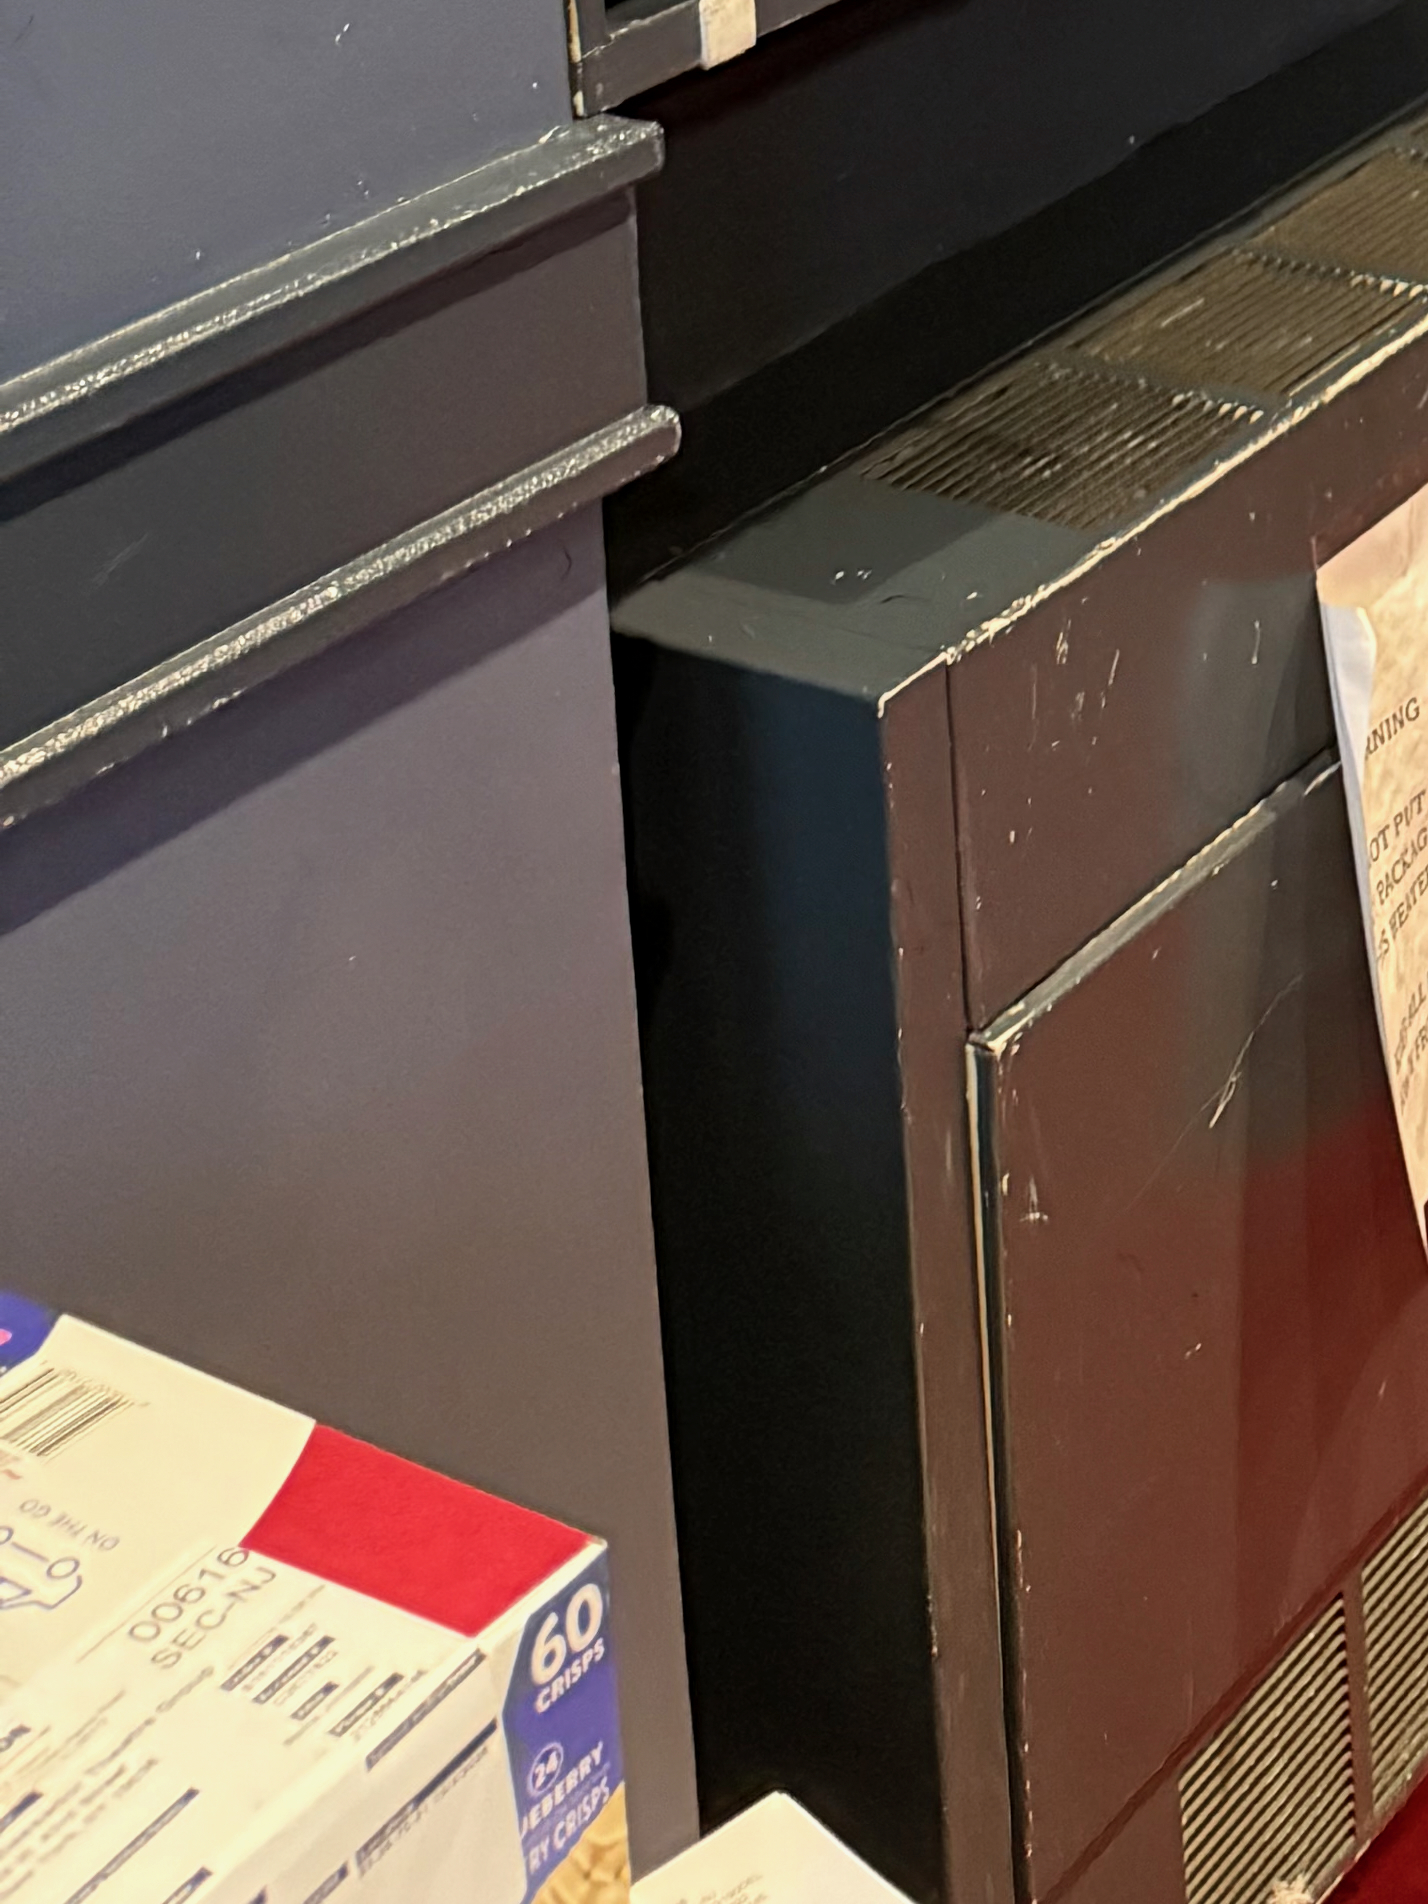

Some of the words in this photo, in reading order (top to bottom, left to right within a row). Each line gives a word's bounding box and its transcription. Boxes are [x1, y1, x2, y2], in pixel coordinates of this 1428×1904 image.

[1394, 788, 1427, 838] PUT
[151, 1566, 277, 1670] SEC-NJ
[531, 1583, 603, 1687] 60
[535, 1637, 604, 1714] CRISPS
[534, 1750, 559, 1789] 24
[553, 1776, 610, 1851] CRISPS
